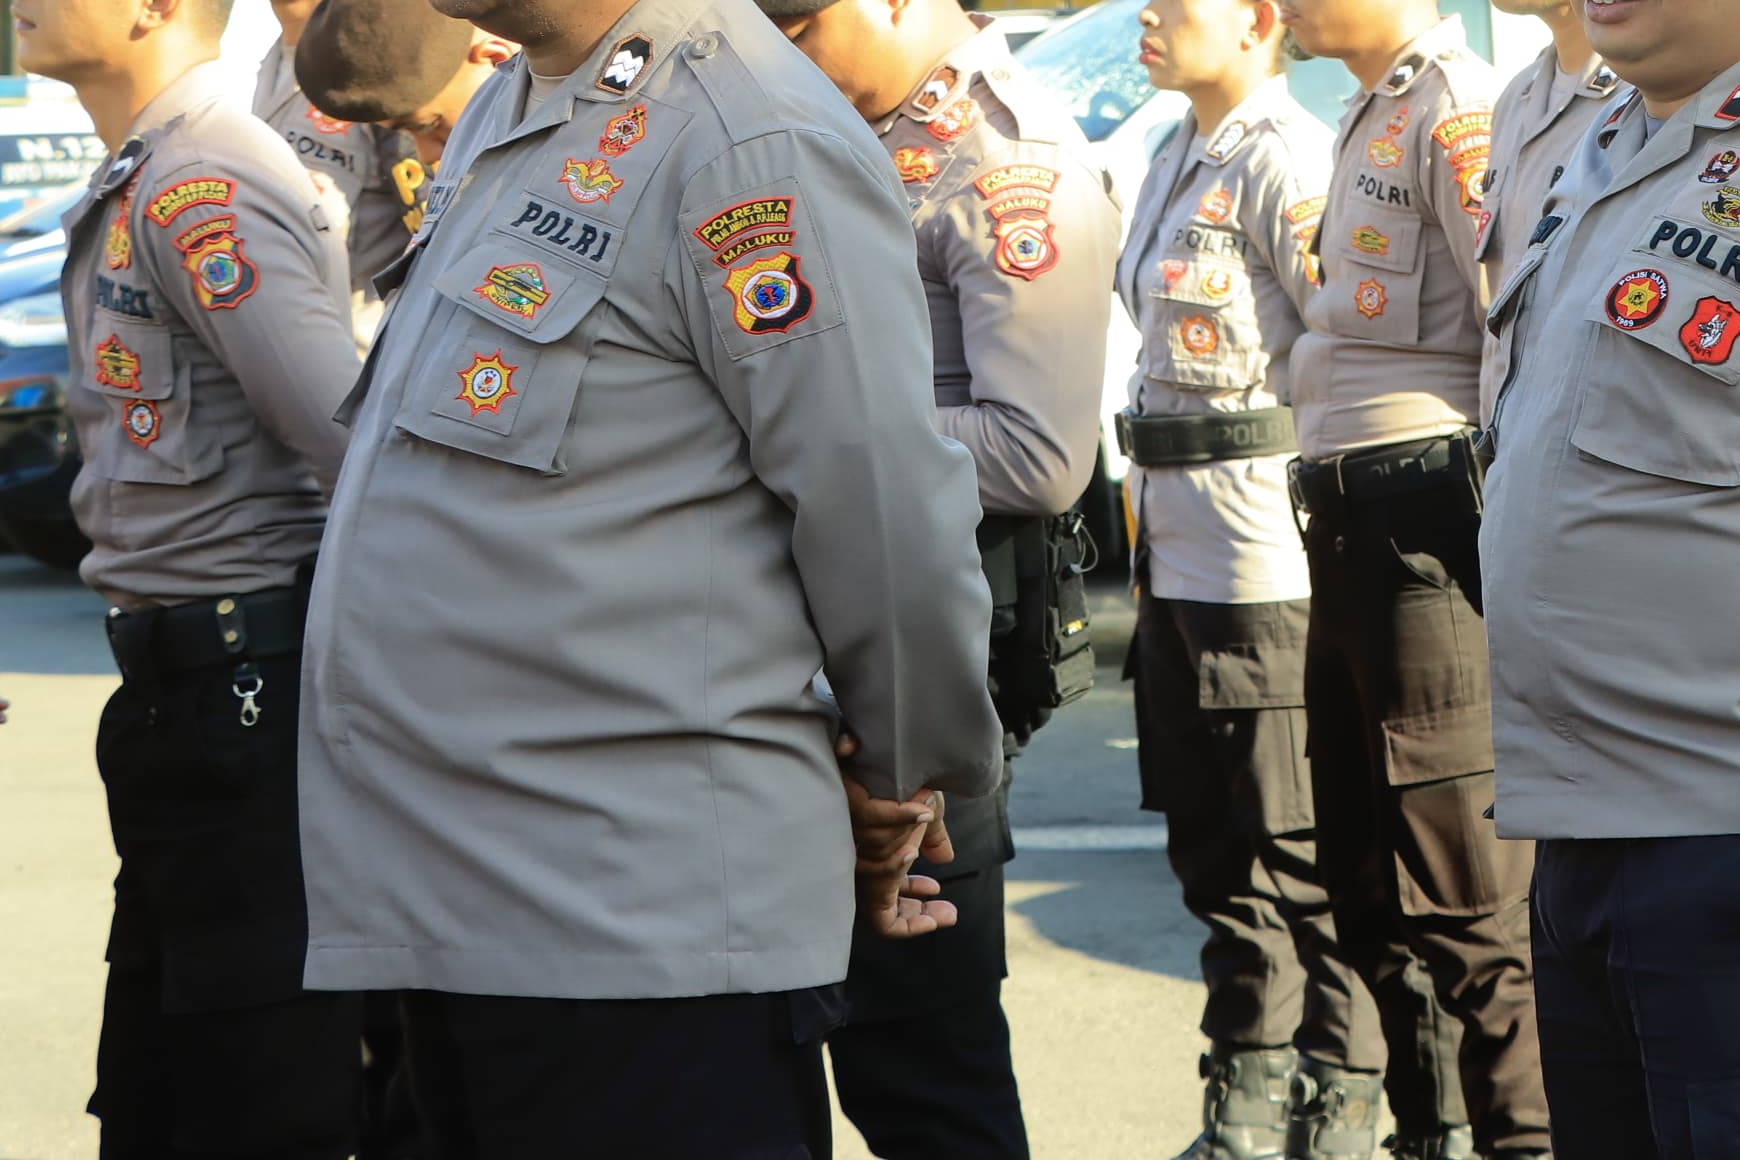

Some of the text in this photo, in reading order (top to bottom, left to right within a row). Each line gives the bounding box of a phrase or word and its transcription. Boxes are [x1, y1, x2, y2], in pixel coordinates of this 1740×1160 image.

[150, 181, 229, 216] POLRESTA
[995, 197, 1047, 214] MALUKU
[1357, 173, 1410, 207] POLRI
[179, 220, 230, 246] MALUKU
[510, 201, 612, 263] POLRI
[700, 201, 788, 239] POLRESTA
[721, 233, 790, 264] MALUKU
[1173, 229, 1248, 257] POLRI
[1618, 271, 1668, 300] POLISI SATWA
